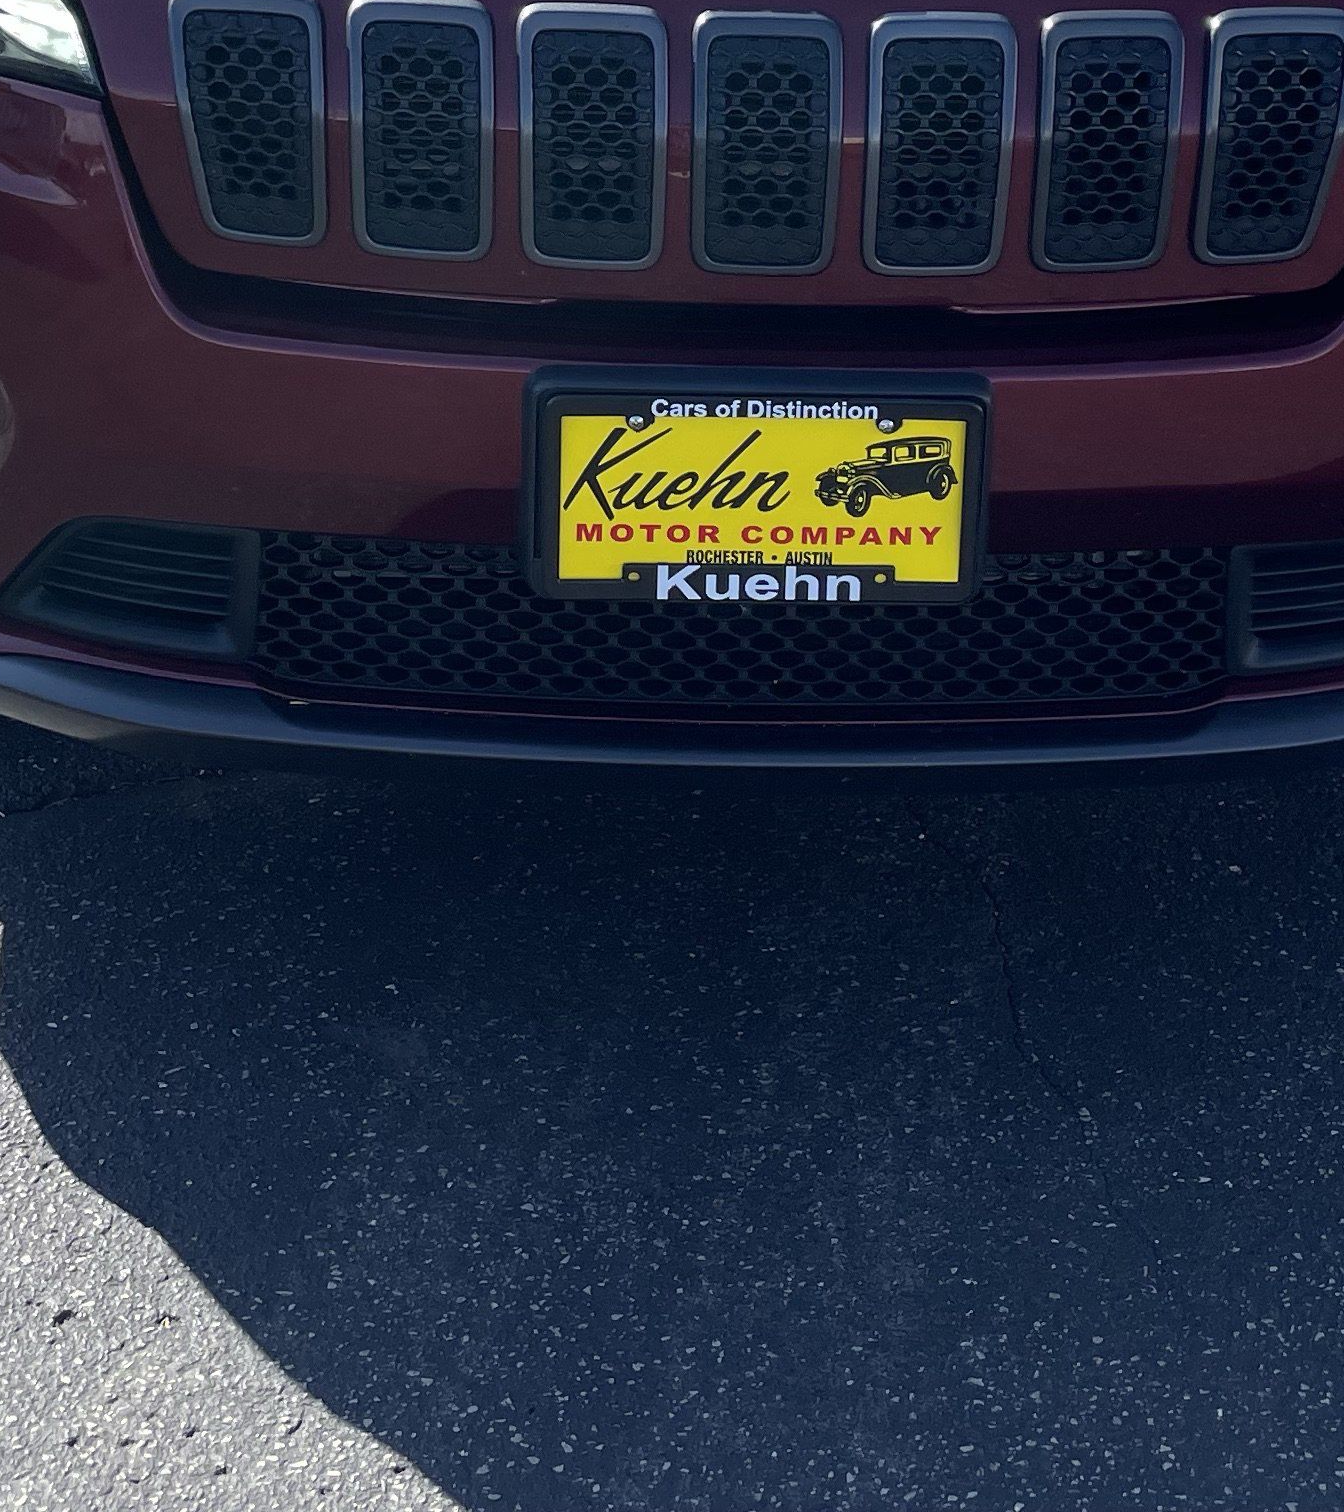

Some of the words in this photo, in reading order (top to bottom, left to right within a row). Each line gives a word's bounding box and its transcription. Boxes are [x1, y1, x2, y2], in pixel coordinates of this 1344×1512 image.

[650, 398, 708, 418] Cars
[716, 399, 740, 418] of
[746, 400, 879, 420] Distinction
[563, 426, 791, 521] Kuehn
[576, 523, 721, 543] MOTOR
[741, 525, 943, 545] COMPANY
[686, 549, 765, 565] ROCHESTER
[785, 550, 834, 566] AUSTIN
[656, 564, 861, 601] Kuehn
